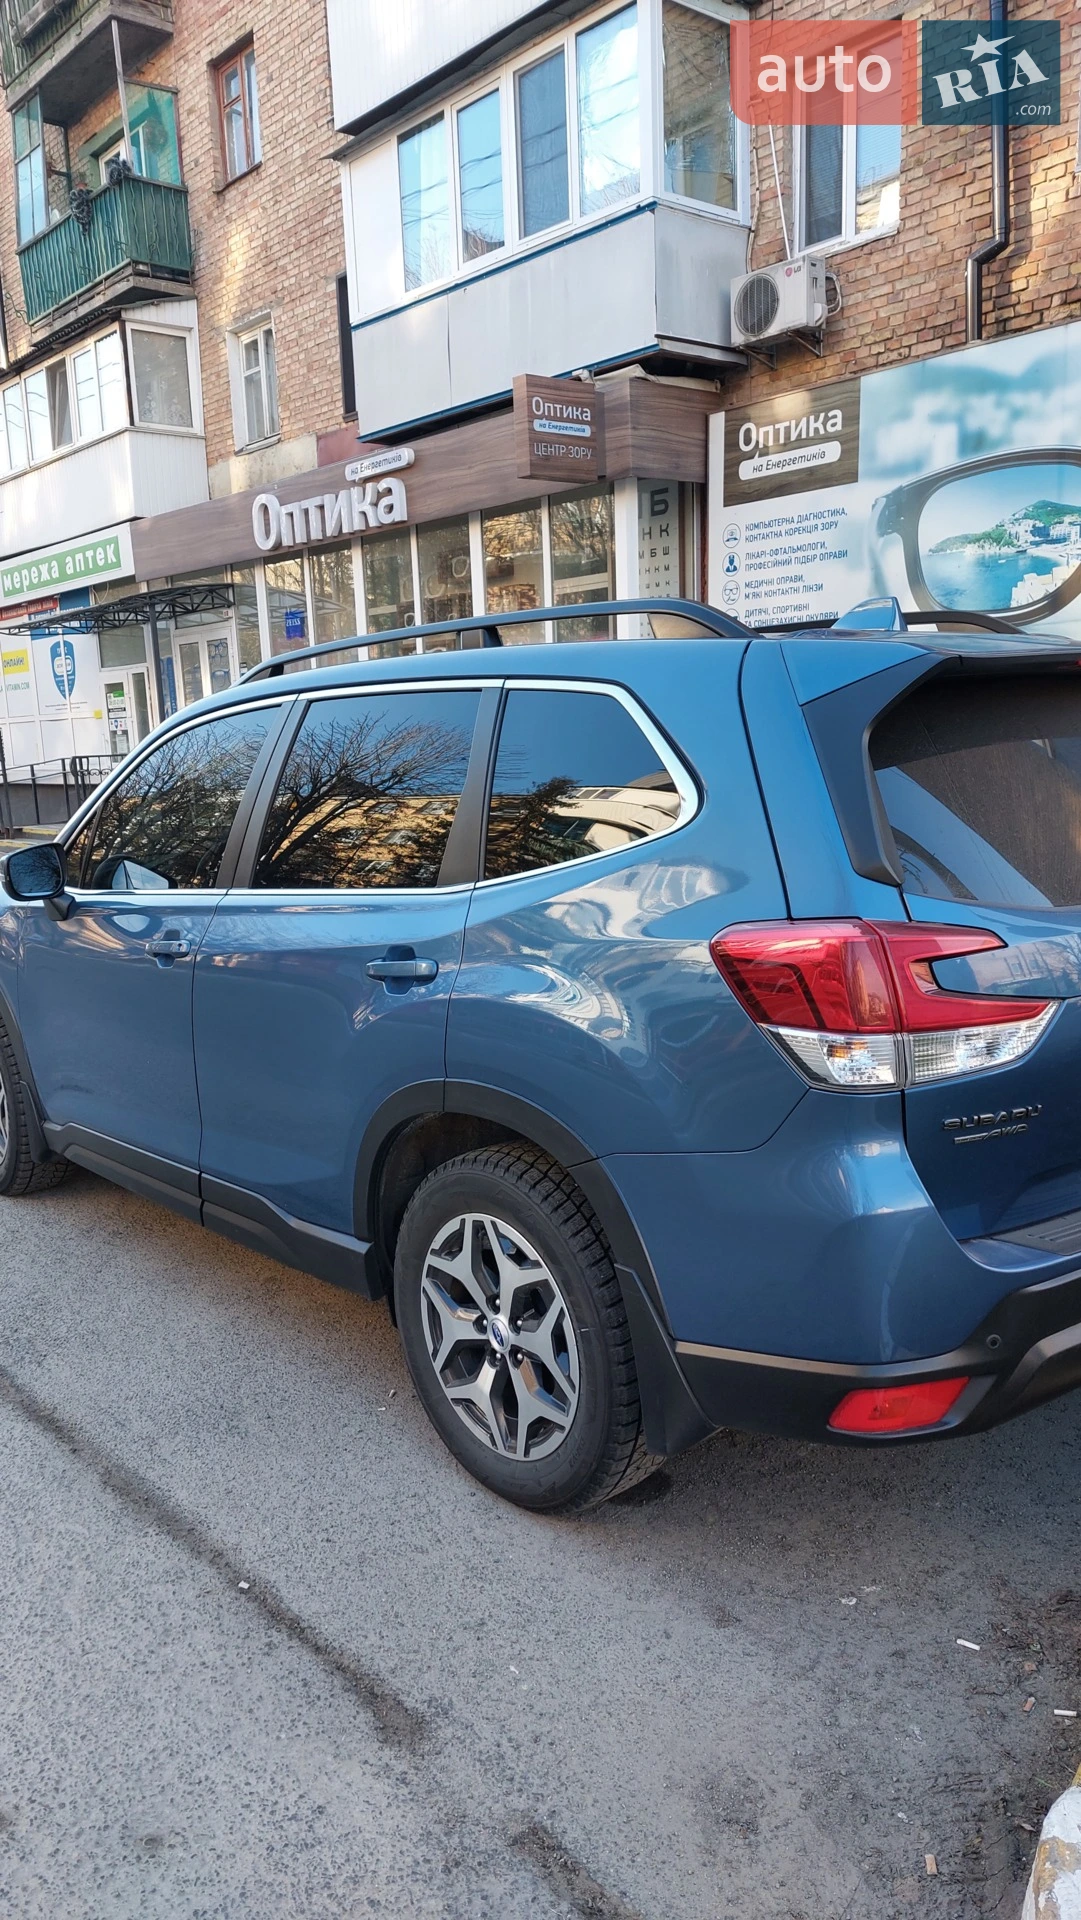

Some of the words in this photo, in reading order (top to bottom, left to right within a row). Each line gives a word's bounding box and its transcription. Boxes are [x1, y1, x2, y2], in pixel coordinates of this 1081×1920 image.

[793, 265, 802, 274] LG
[532, 397, 591, 421] Оптика
[547, 422, 586, 433] Енергетиків
[738, 409, 843, 452] Оптика
[534, 442, 566, 456] ЦЕНТР
[568, 446, 592, 460] ЗОРУ
[752, 463, 764, 474] на
[765, 448, 826, 471] Енергетиків
[350, 466, 359, 476] на
[360, 454, 402, 473] Енергетиків
[252, 477, 408, 551] Оптика
[796, 507, 847, 524] ДІАГНОСТИКА,
[745, 530, 783, 543] КОНТАКТНА
[784, 523, 819, 536] КОРЕКЦІЯ
[820, 520, 839, 531] ЗОРУ
[745, 541, 827, 561] ЛІКАРІ-ОФТАЛЬМОЛОГИ,
[745, 556, 793, 572] ПРОФЕСІЙНИЙ
[794, 554, 818, 567] ПІДБІР
[819, 549, 848, 561] ОПРАВИ
[3, 560, 60, 592] мережа
[65, 543, 117, 575] аптек
[744, 590, 763, 600] М'ЯКІ
[764, 586, 800, 598] КОНТАКТНІ
[801, 583, 824, 594] ЛІНЗИ
[745, 579, 775, 590] МЕДИЧНІ
[776, 574, 805, 586] ОПРАВИ,
[745, 608, 770, 620] ДИТЯЧІ,
[772, 603, 810, 615] СПОРТИВНІ
[942, 1104, 1042, 1130] SUBARU
[983, 1123, 1029, 1140] AWD
